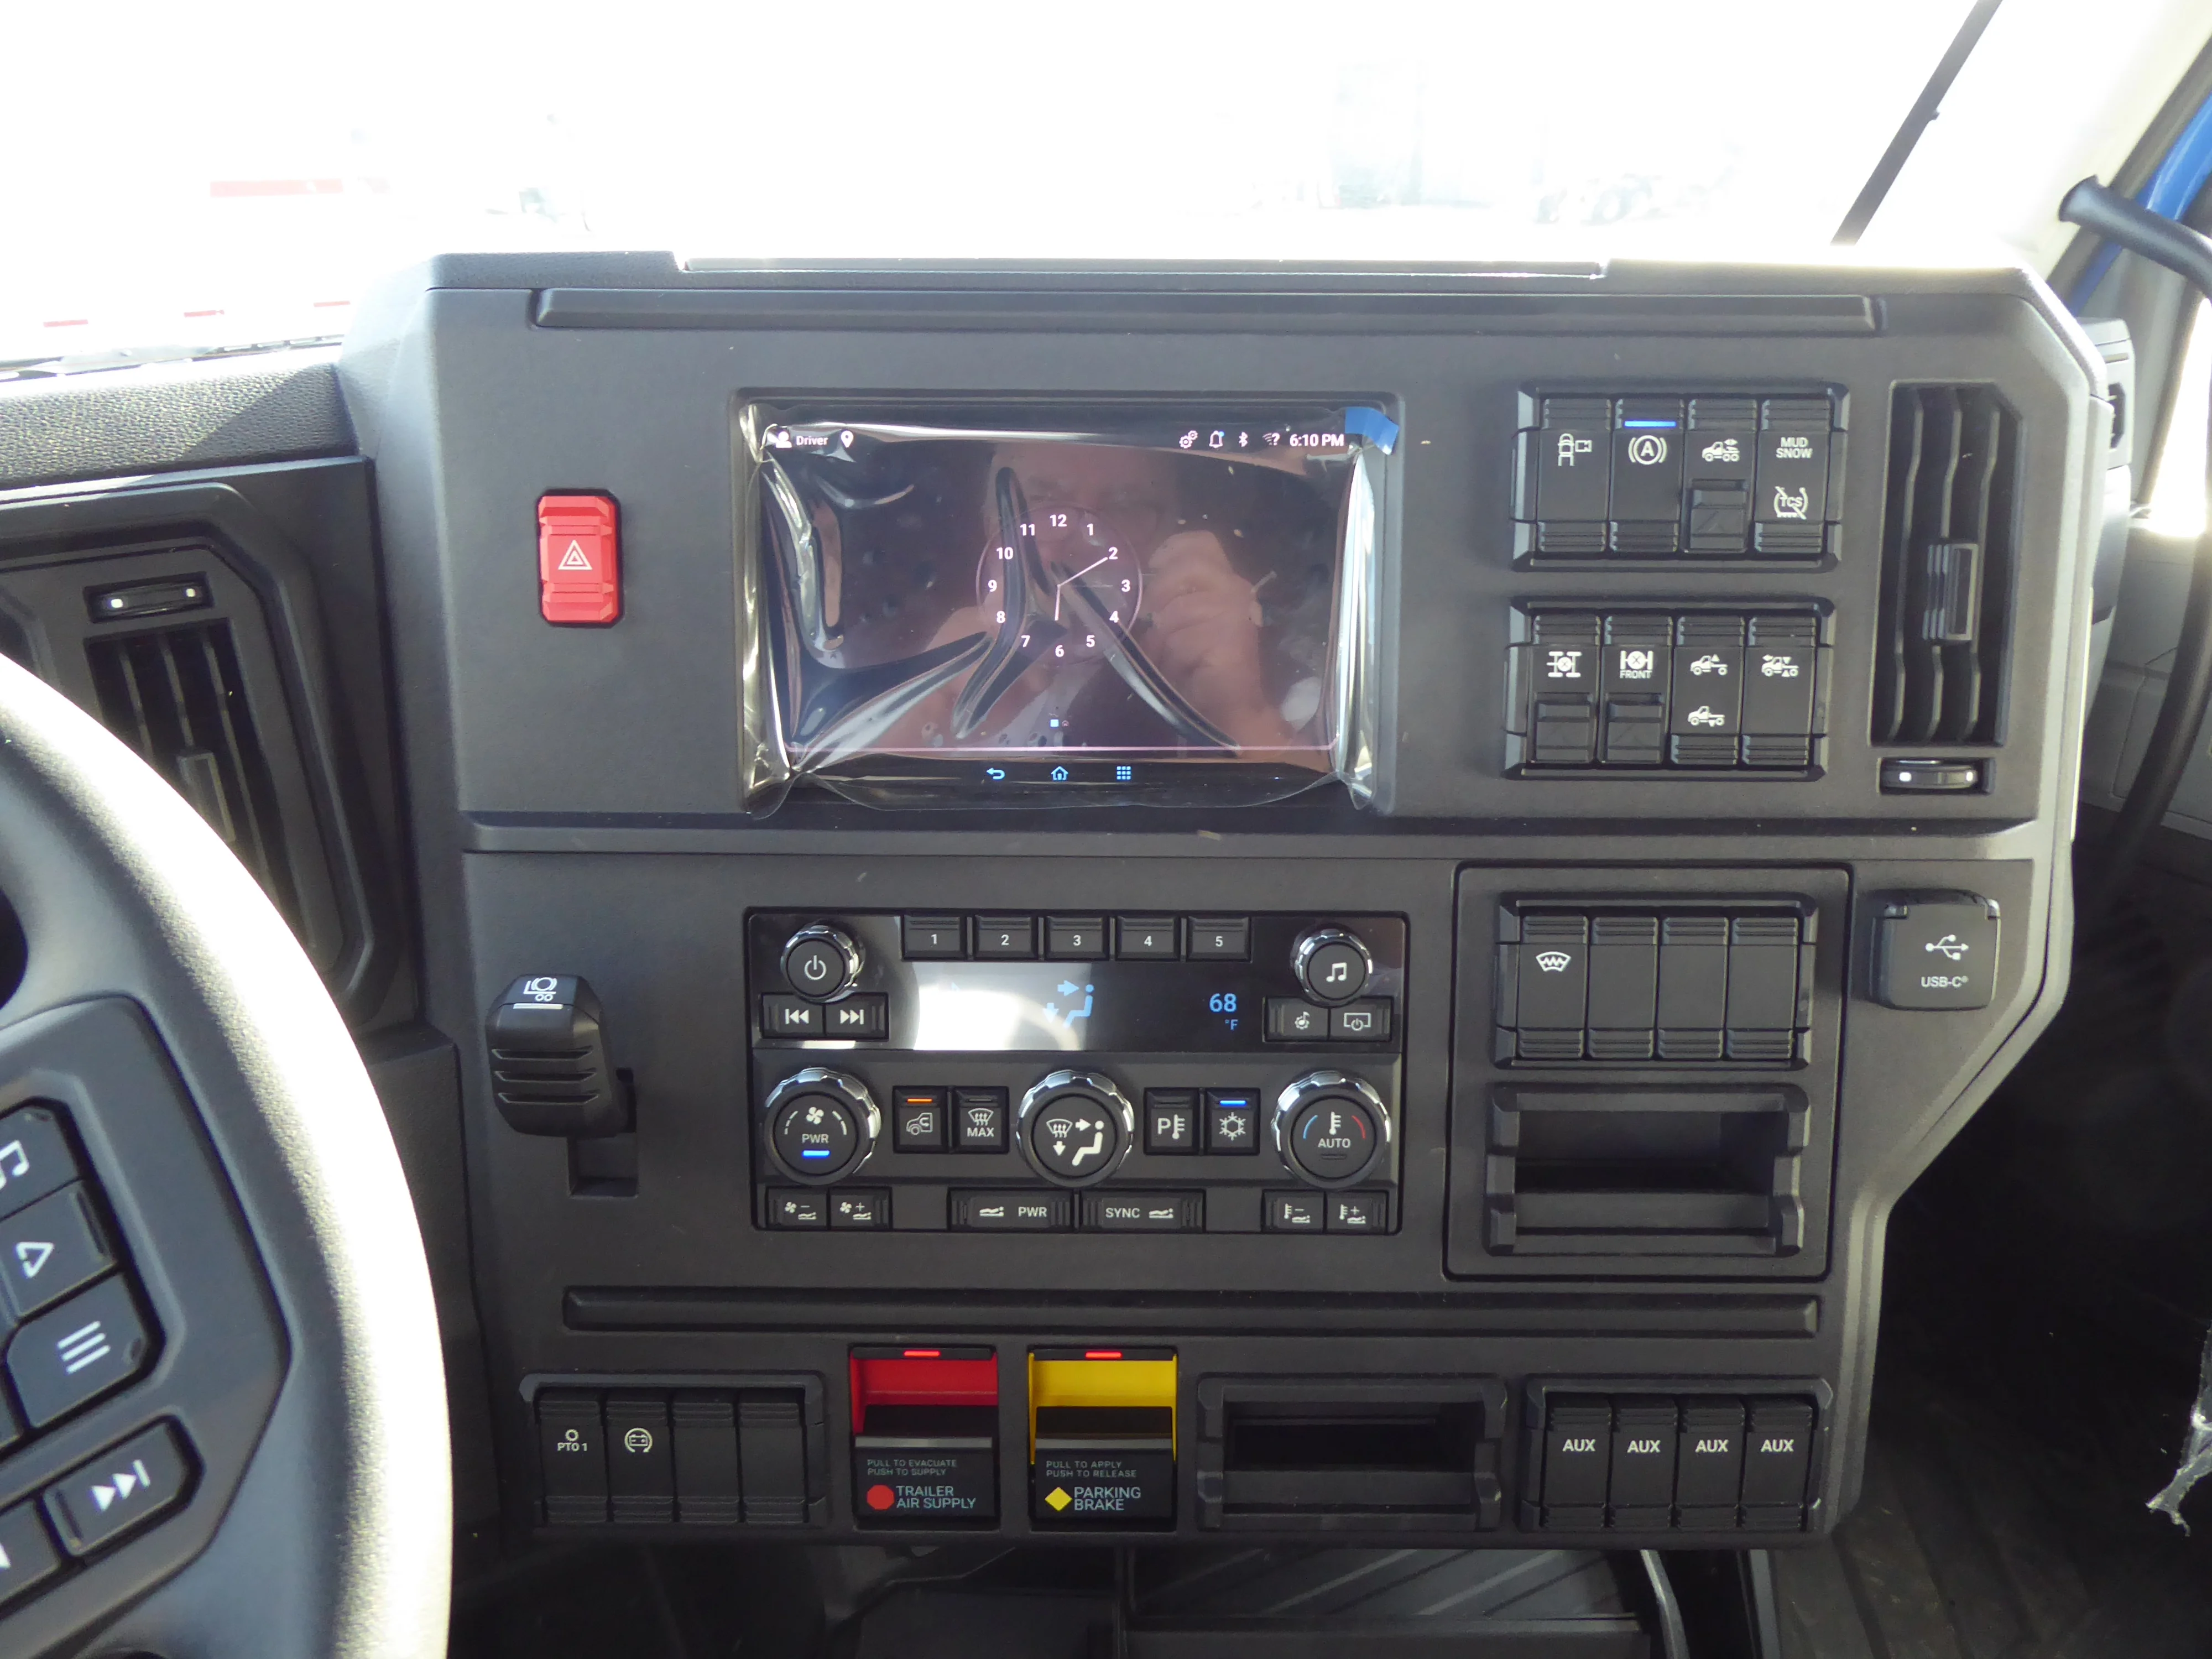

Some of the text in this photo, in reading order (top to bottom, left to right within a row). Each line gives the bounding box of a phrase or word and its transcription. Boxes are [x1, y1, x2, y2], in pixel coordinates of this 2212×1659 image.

[796, 435, 828, 446] Driver
[1290, 434, 1344, 446] 6:10 PM
[1780, 437, 1809, 447] MUD
[1776, 447, 1812, 458] SNOW
[1779, 495, 1803, 508] TCS
[1050, 514, 1067, 526] 12
[1020, 524, 1035, 535] 11
[1087, 524, 1093, 535] 1
[997, 547, 1013, 560] 10
[1109, 547, 1118, 560] 2
[988, 580, 997, 592] 9
[1121, 580, 1130, 592] 3
[997, 611, 1005, 623] 8
[1109, 611, 1119, 623] 4
[1021, 635, 1030, 647] 7
[1086, 635, 1095, 647] 5
[1055, 645, 1064, 657] 6
[1620, 670, 1652, 679] FRONT
[931, 934, 937, 944] 1
[1001, 935, 1009, 945] 2
[1073, 935, 1081, 946] 3
[1144, 936, 1152, 946] 4
[1216, 936, 1223, 947] 5
[1209, 993, 1237, 1012] 68
[1157, 1118, 1170, 1134] P
[967, 1128, 994, 1136] MAX
[802, 1134, 828, 1143] PWR
[1318, 1138, 1350, 1148] AUTO
[1019, 1207, 1047, 1217] PWR
[1106, 1208, 1140, 1218] SYNC
[557, 1442, 580, 1452] PTO
[1563, 1439, 1595, 1451] AUX
[1627, 1440, 1660, 1452] AUX
[1695, 1440, 1728, 1452] AUX
[1761, 1439, 1793, 1452] AUX
[896, 1486, 954, 1496] TRAILER
[1074, 1487, 1141, 1498] PARKING
[896, 1498, 975, 1508] AIR SUPPLY
[1074, 1499, 1124, 1510] BRAKE
